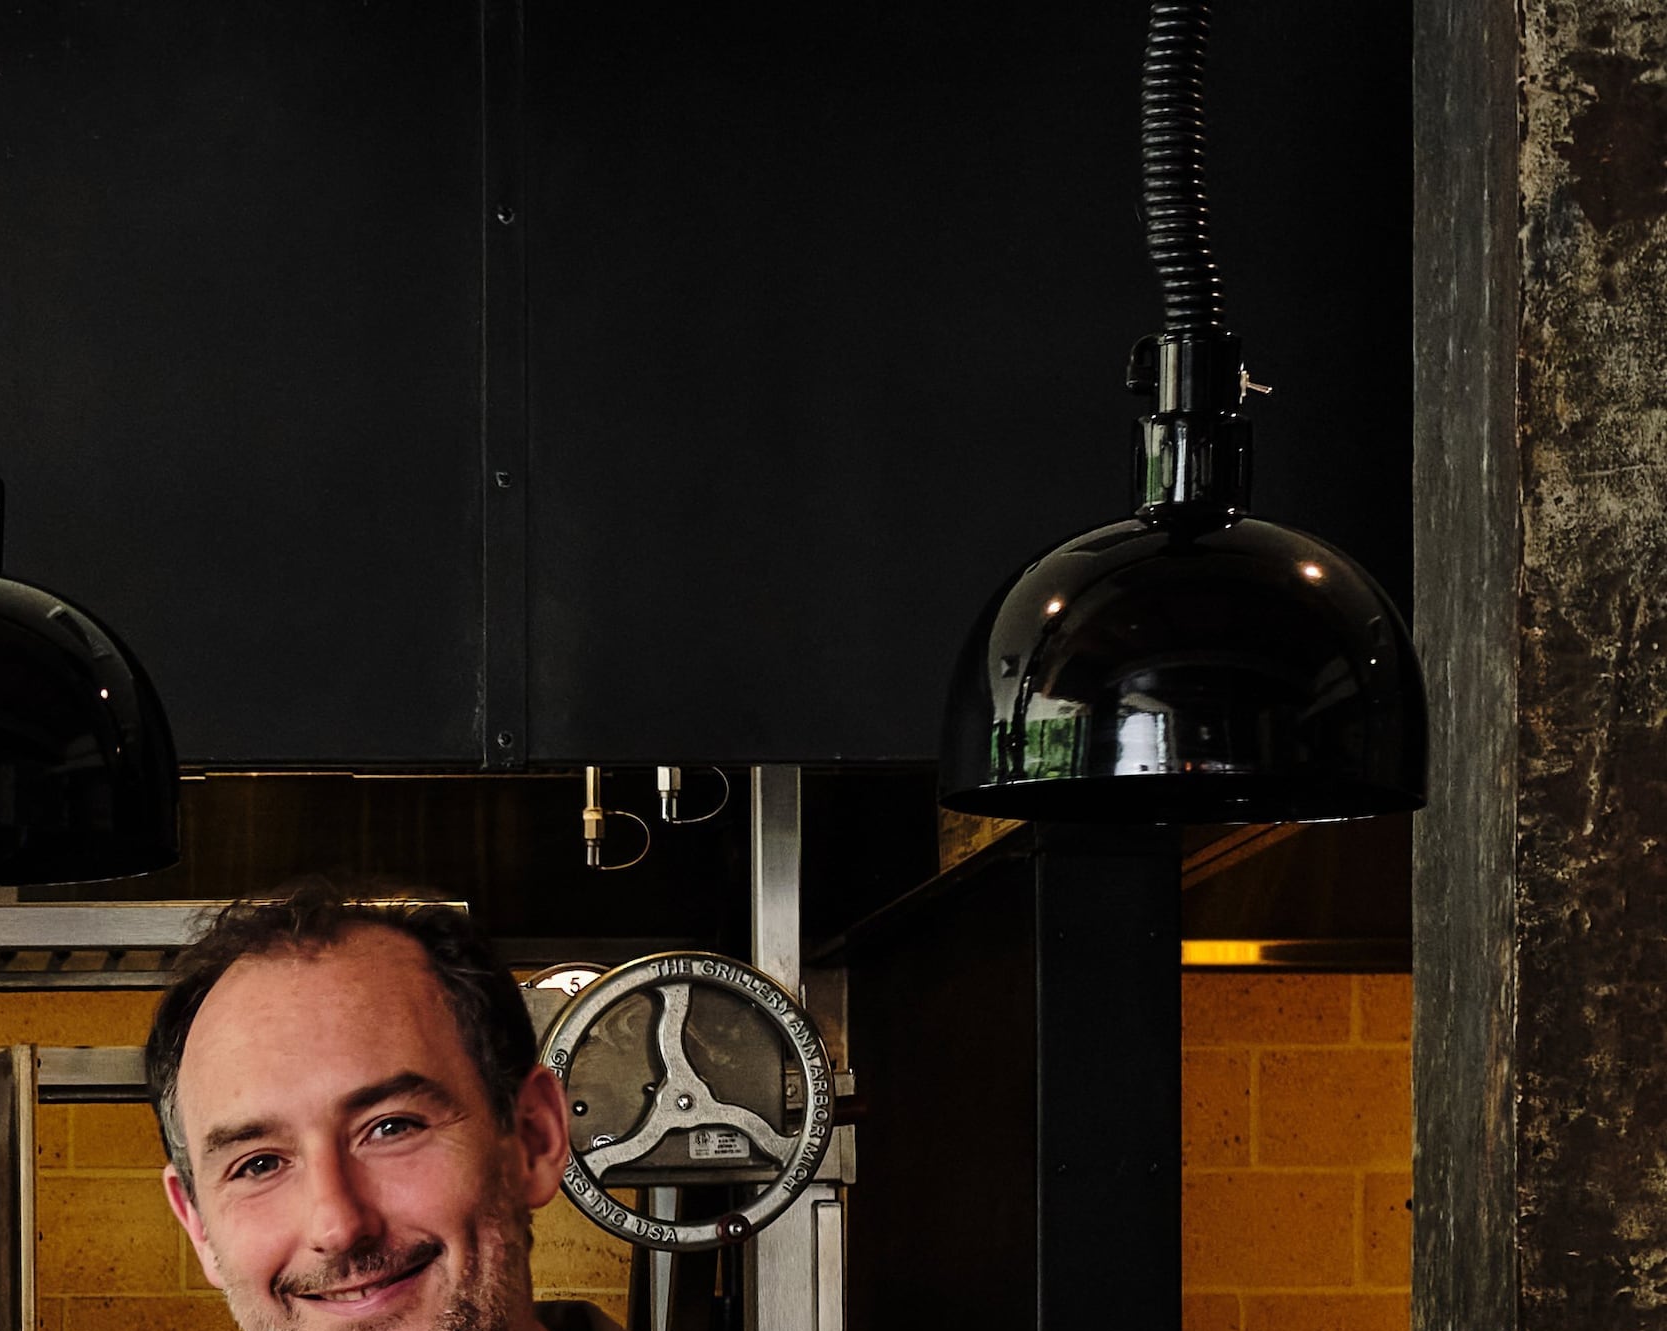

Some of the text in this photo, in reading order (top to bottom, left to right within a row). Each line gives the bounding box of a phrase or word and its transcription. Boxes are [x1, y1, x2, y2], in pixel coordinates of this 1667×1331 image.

[570, 977, 580, 994] 5
[650, 959, 829, 1192] THE GRILLERY ANN ARBOR MICH
[590, 1196, 627, 1226] INC
[634, 1218, 678, 1243] USA
